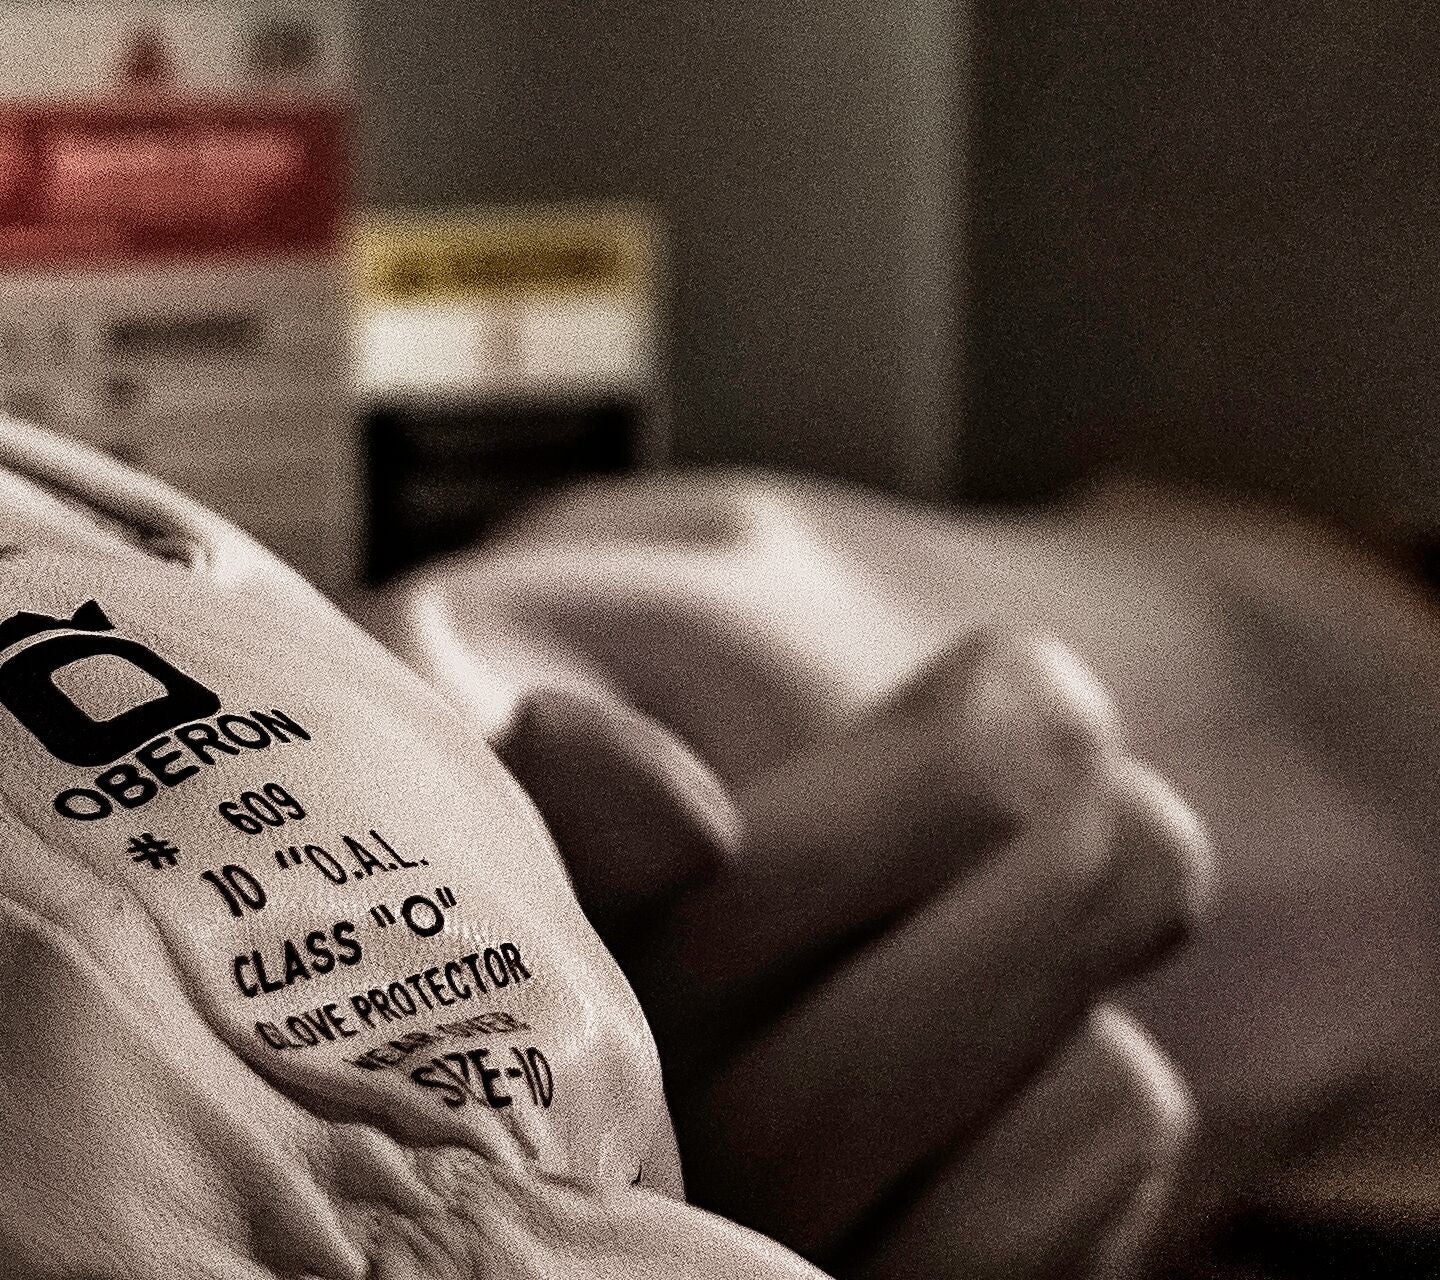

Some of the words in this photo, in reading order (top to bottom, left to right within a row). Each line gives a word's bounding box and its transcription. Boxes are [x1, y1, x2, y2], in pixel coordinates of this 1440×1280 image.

[53, 708, 312, 822] OBERON
[127, 833, 180, 871] #
[217, 782, 307, 835] 609
[201, 864, 267, 918] 10
[233, 922, 363, 998] CLASS
[255, 1004, 357, 1051] GLOVE
[350, 941, 532, 1030] PROTECTOR
[411, 1046, 555, 1110] SIZE-10
